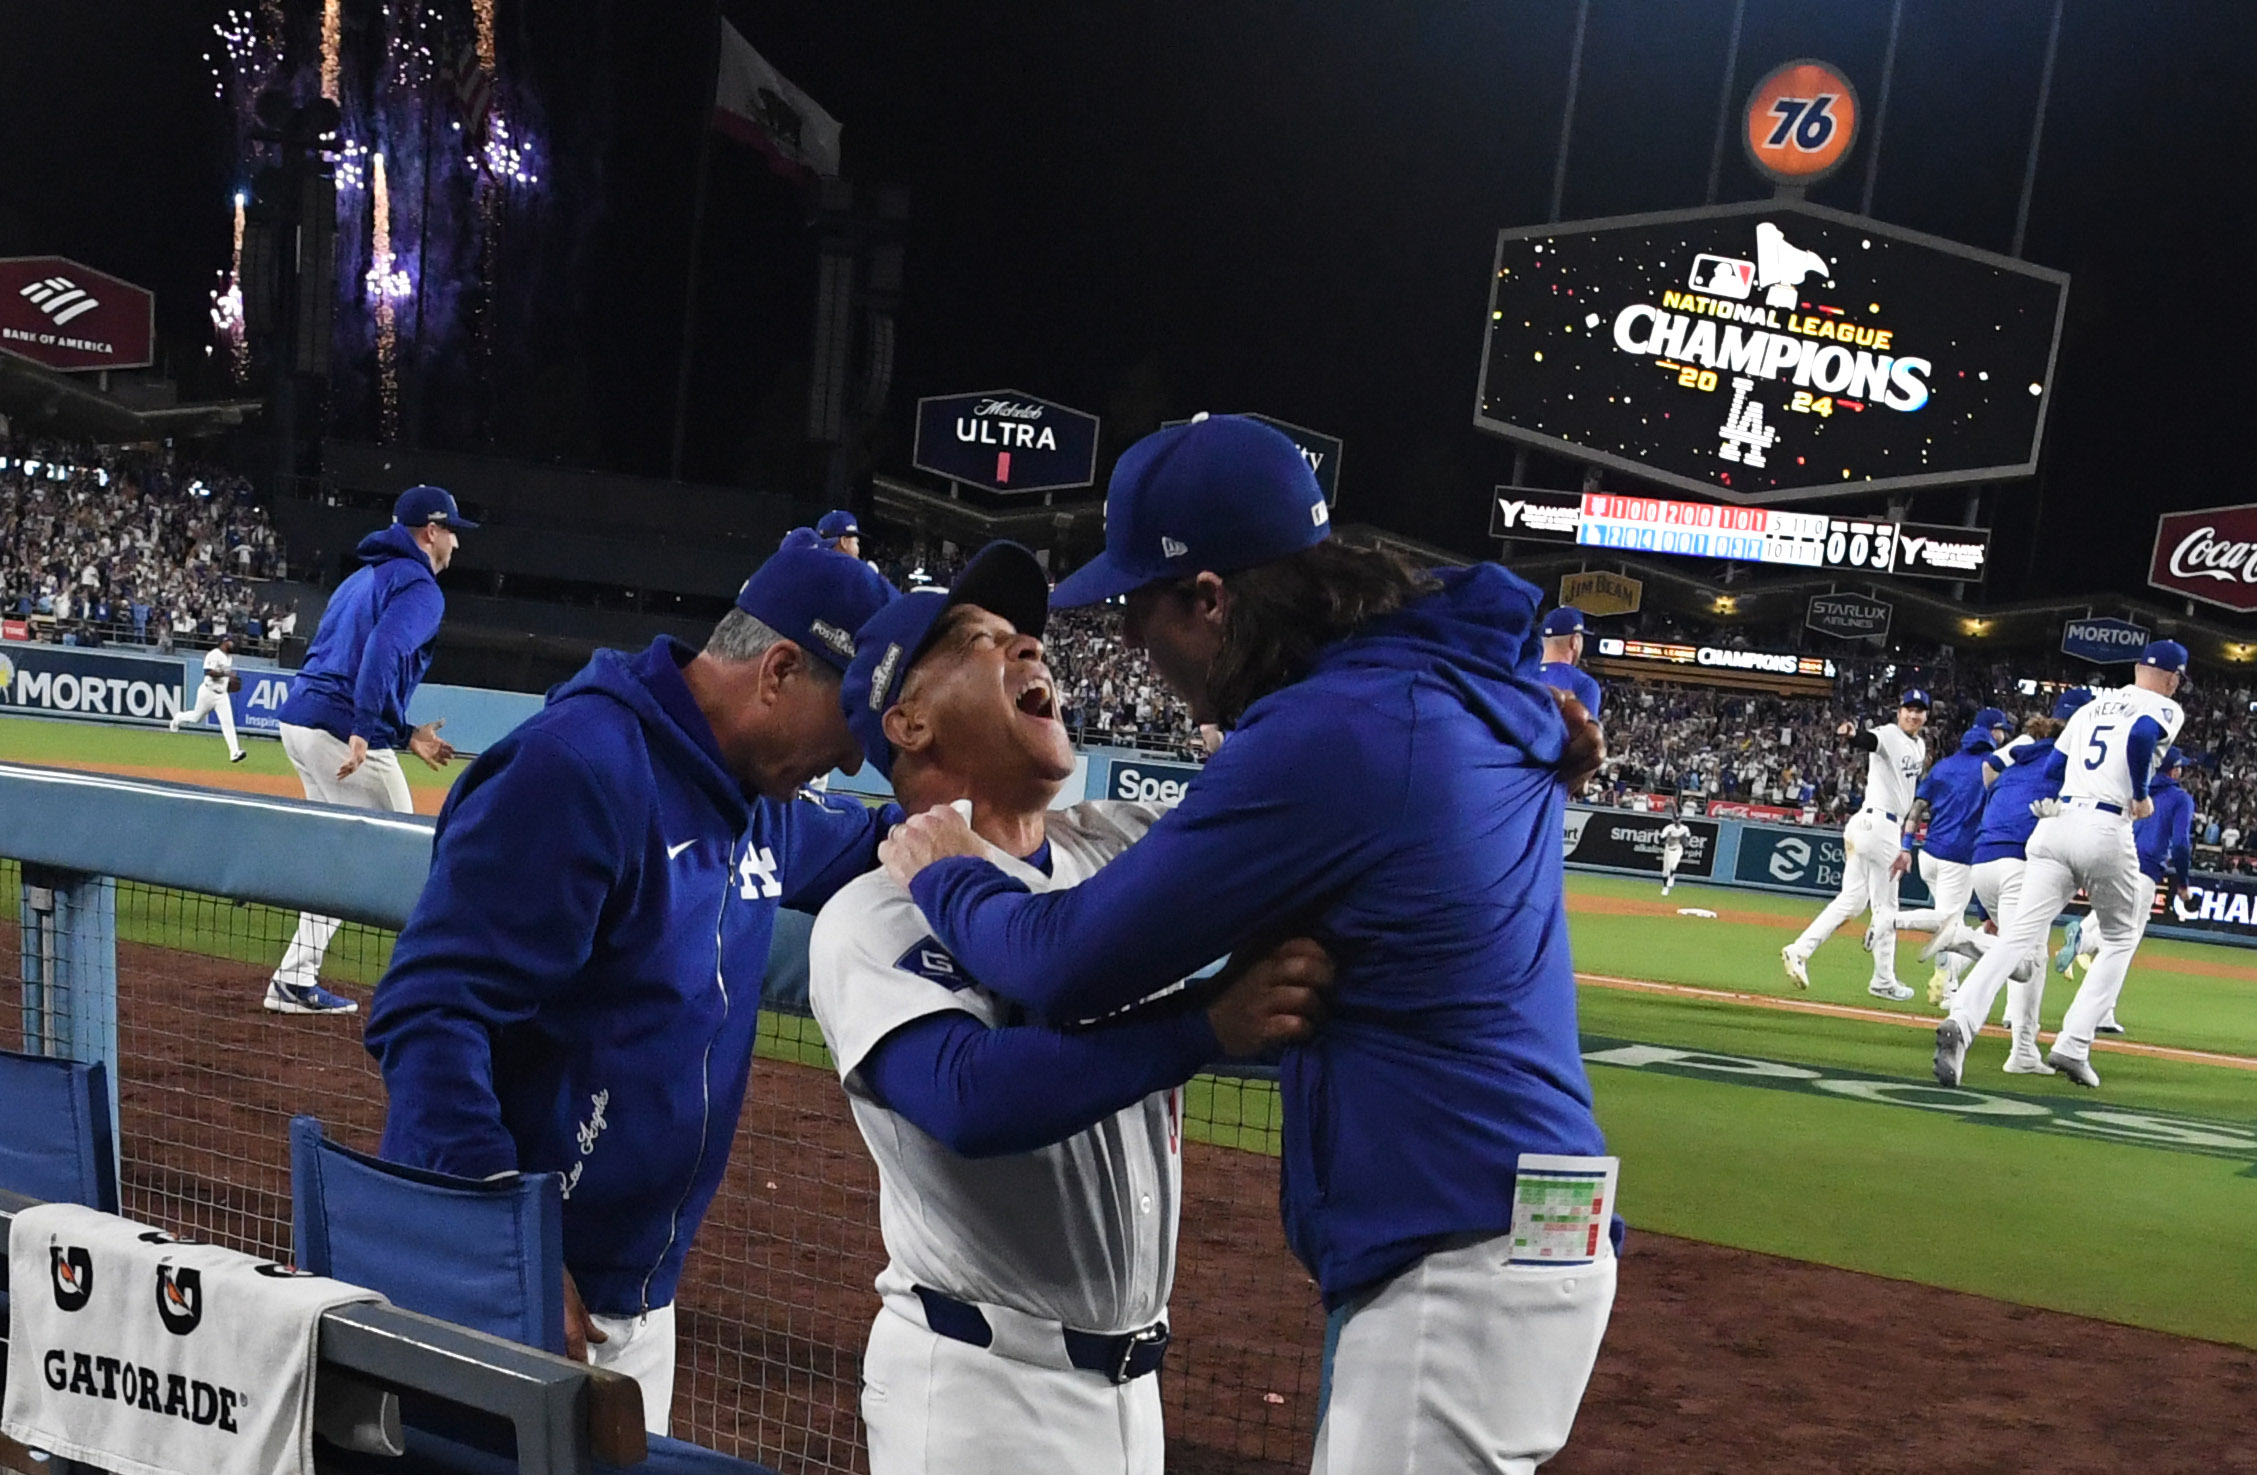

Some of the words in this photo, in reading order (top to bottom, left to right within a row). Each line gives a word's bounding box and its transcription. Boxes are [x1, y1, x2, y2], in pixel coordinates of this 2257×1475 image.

[1762, 94, 1840, 153] 76
[3, 328, 37, 342] BANK
[39, 334, 55, 344] OF
[58, 337, 113, 353] AMERICA
[1663, 290, 1781, 329] NATIONAL
[1788, 313, 1893, 350] LEAGUE
[1613, 304, 1931, 412] CHAMPIONS
[974, 399, 1044, 420] Michelob
[1678, 367, 1717, 392] 20
[1791, 391, 1833, 417] 24
[956, 417, 1056, 450] ULTRA
[1813, 601, 1886, 620] STARLUX
[2068, 624, 2145, 646] MORTON
[1697, 647, 1797, 673] CHAMPIONS
[17, 670, 183, 720] MORTON
[2084, 725, 2115, 770] 5
[576, 1088, 610, 1155] Angeles
[44, 1349, 238, 1434] GATORADE
